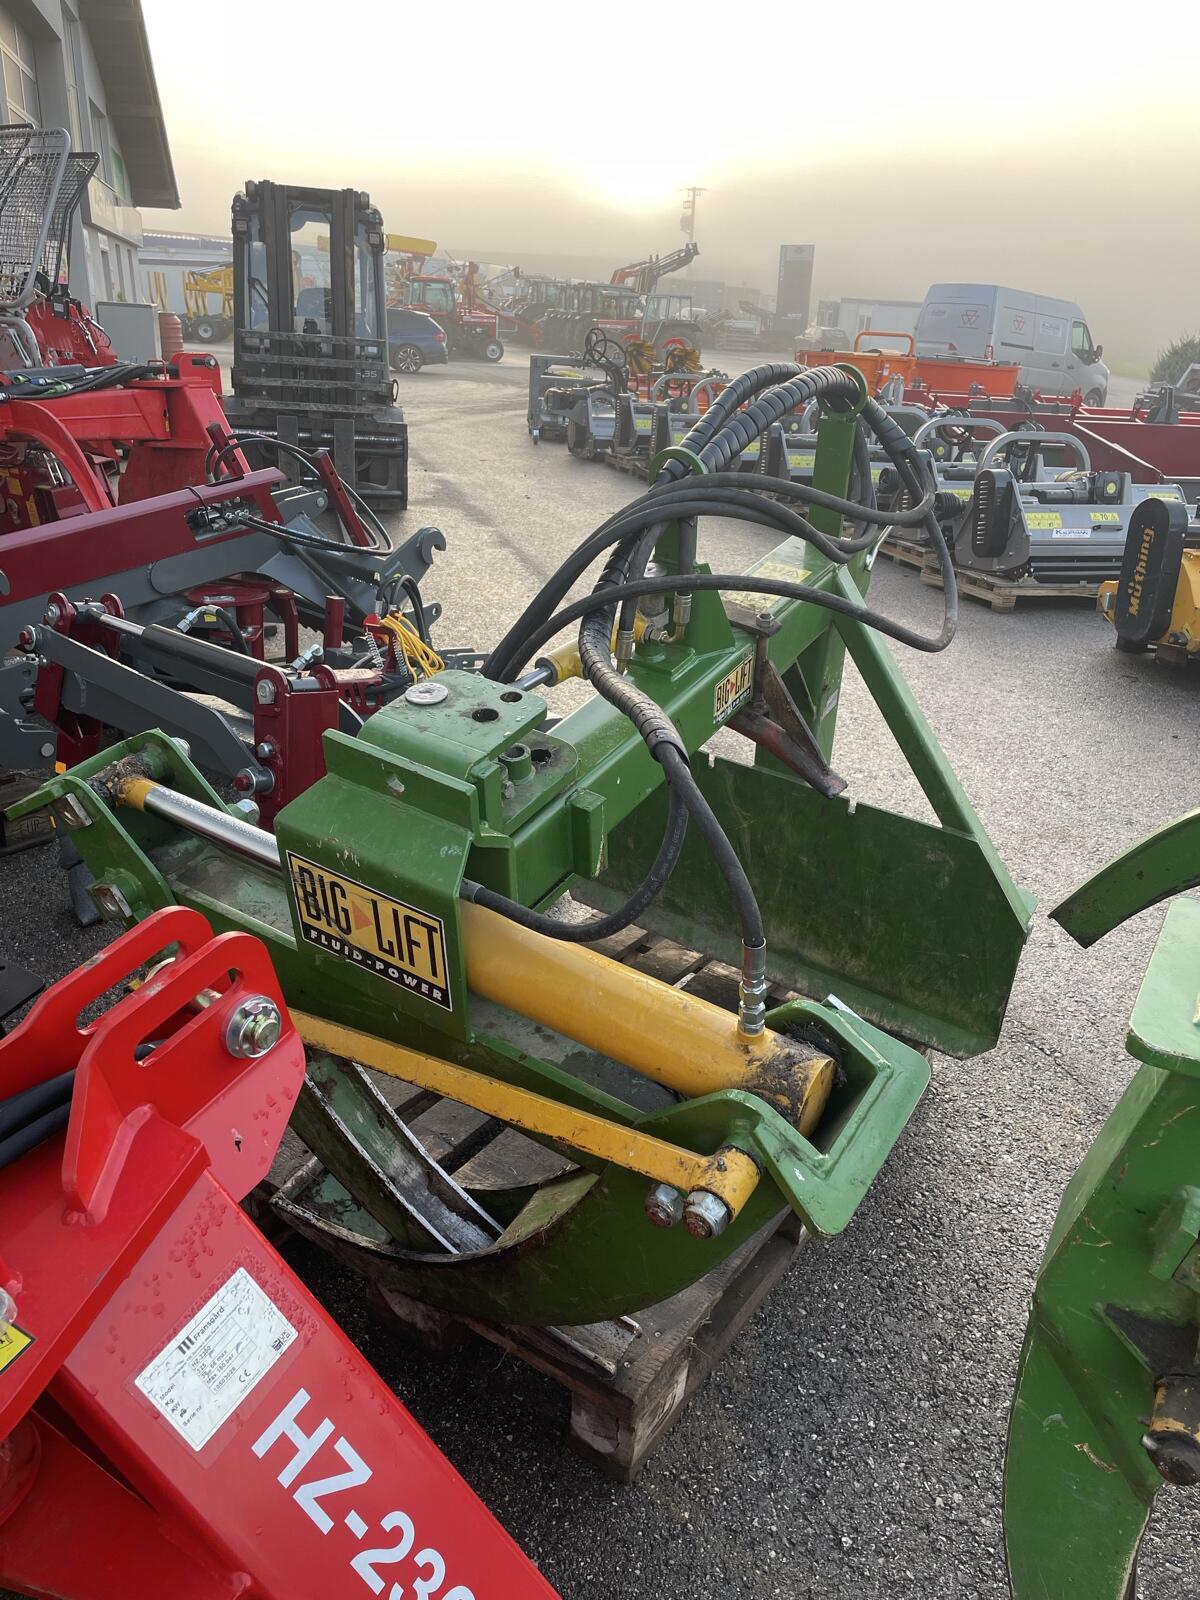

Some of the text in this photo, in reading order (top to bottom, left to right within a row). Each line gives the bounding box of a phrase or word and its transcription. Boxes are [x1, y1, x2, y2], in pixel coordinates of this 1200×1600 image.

[1128, 528, 1155, 616] Müthing
[717, 678, 731, 712] BIG
[735, 659, 752, 695] LIFT
[297, 865, 439, 979] BIG LIFT
[310, 929, 443, 1001] FLUID-POWER
[250, 1387, 476, 1600] HZ-23
